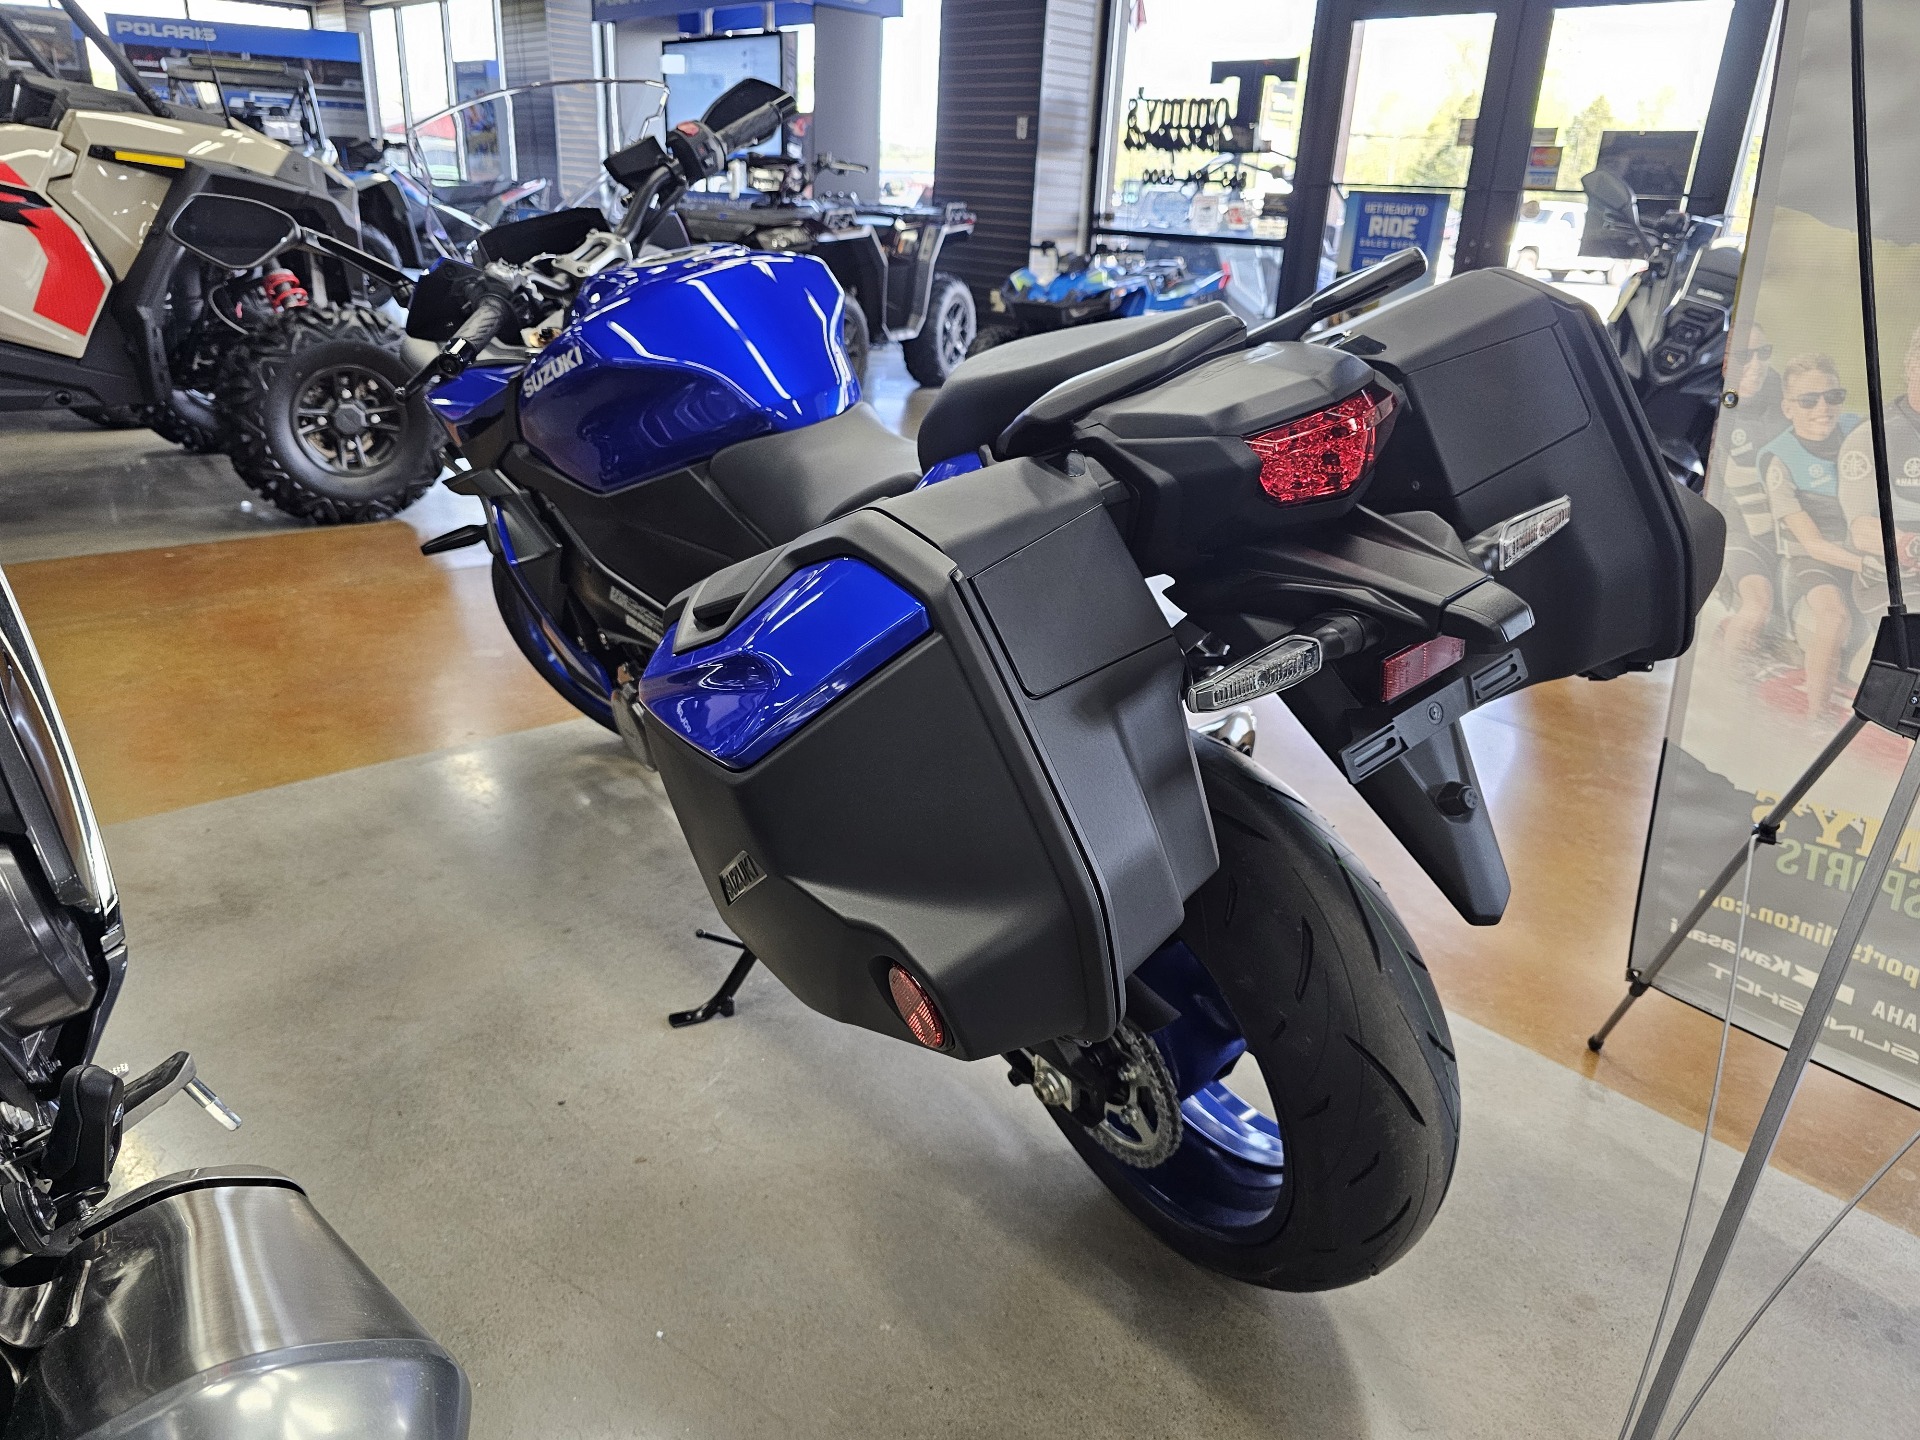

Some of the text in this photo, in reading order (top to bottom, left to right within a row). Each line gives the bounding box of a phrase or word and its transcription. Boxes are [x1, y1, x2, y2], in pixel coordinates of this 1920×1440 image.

[115, 20, 218, 42] POLARIS
[1367, 215, 1419, 240] RIDE
[523, 345, 584, 398] SUZUKI
[722, 853, 760, 900] SUZUKI
